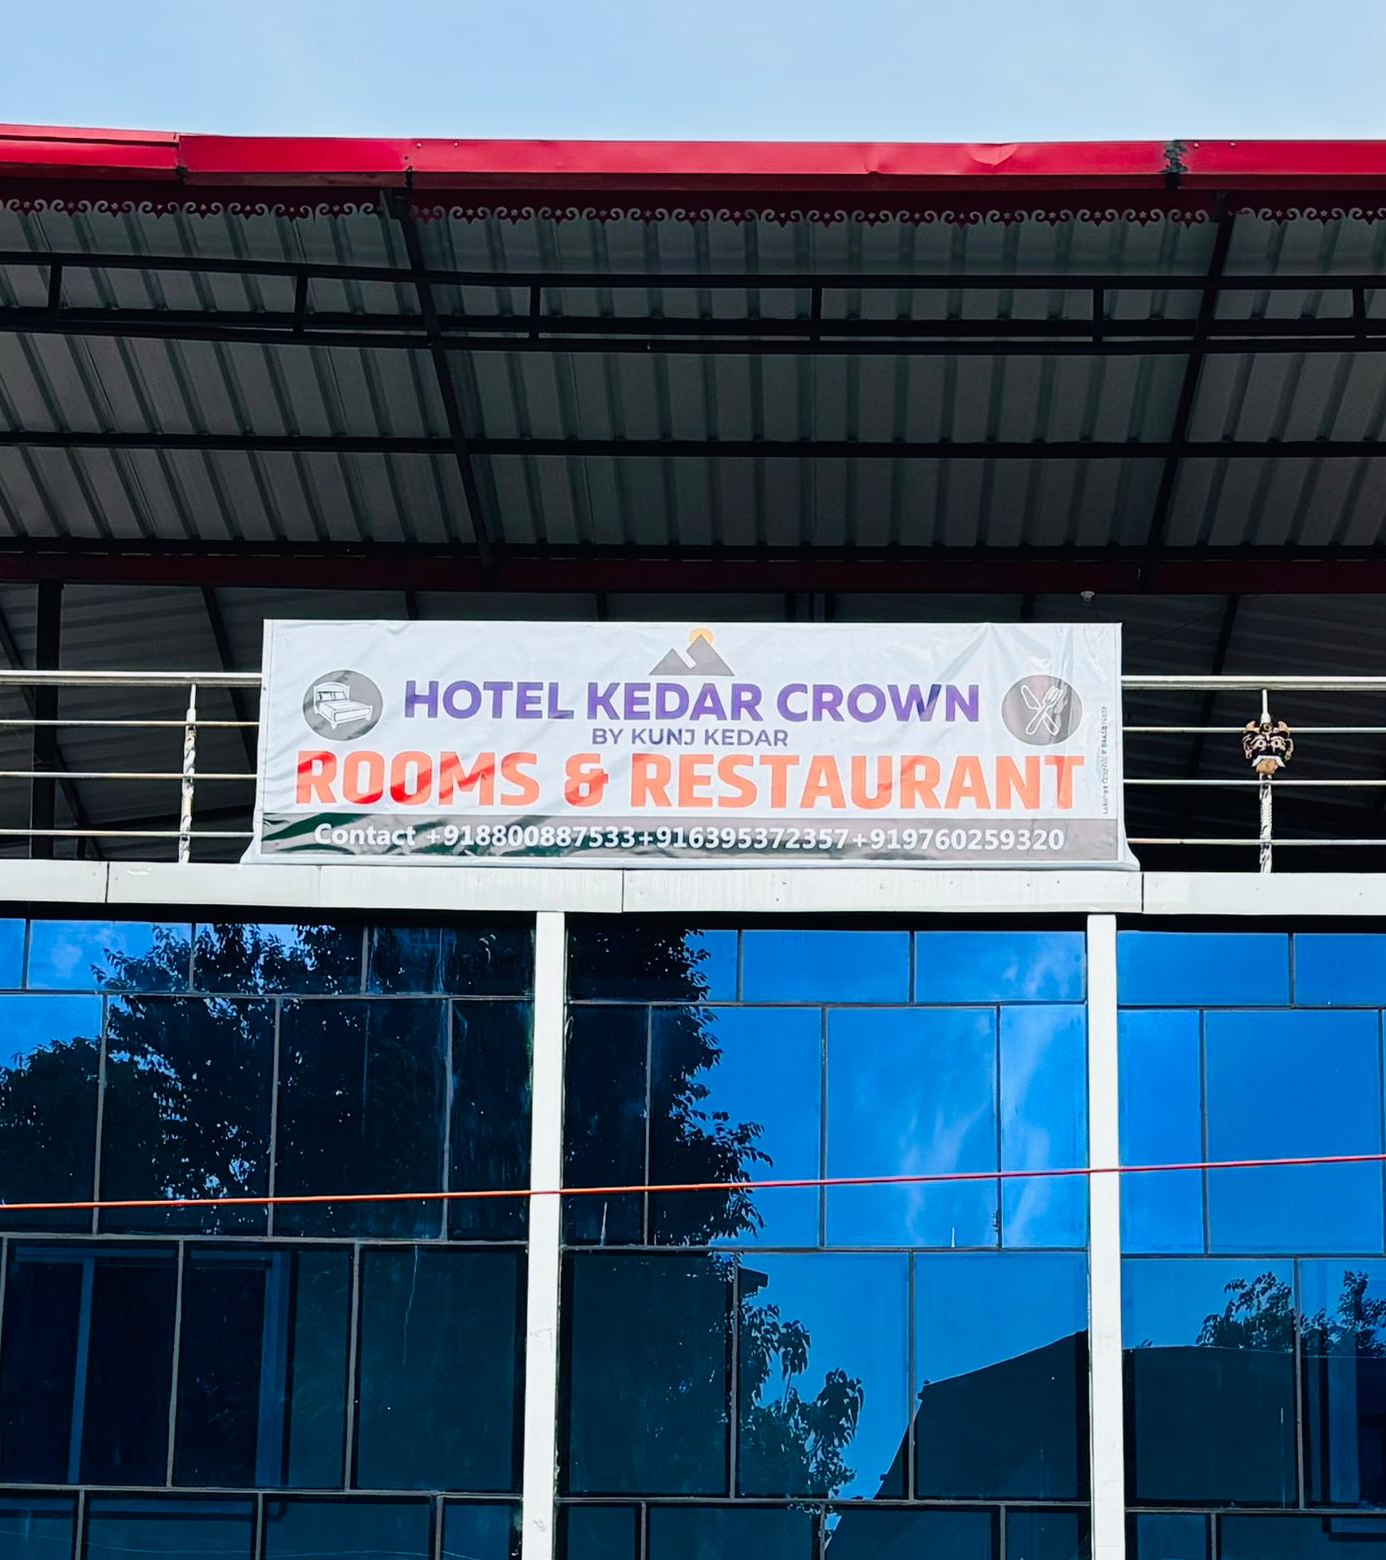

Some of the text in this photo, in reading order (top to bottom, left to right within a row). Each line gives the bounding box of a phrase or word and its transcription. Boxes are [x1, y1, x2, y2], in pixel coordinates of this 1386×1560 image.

[403, 679, 981, 723] HOTEL KEDAR CROWN
[591, 728, 789, 747] BY KUNJ KEDAR
[295, 749, 541, 808] ROOMS
[563, 752, 610, 809] &
[629, 752, 1086, 811] RESTAURANT
[312, 822, 417, 847] Contact
